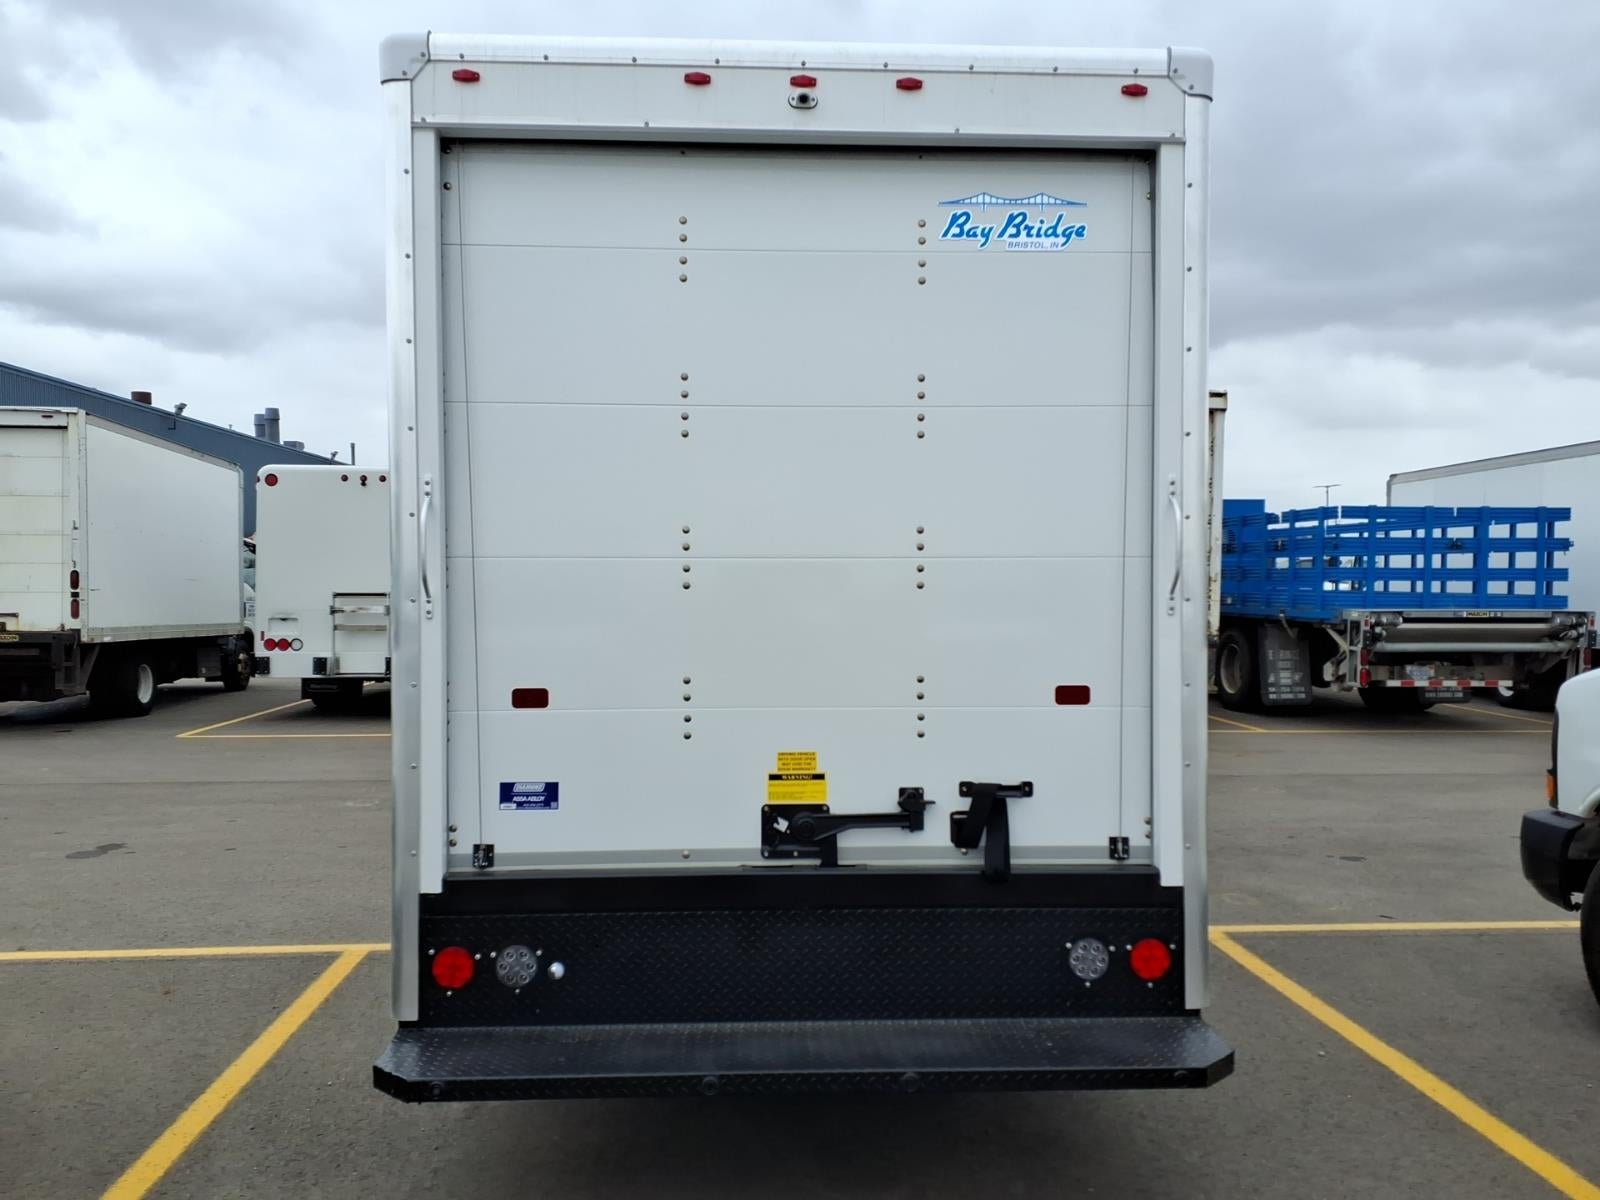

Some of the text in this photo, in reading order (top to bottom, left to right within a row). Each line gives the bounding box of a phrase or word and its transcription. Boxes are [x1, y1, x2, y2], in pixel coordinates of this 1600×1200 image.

[941, 210, 1086, 249] Bay Bridge
[1049, 241, 1059, 249] IN
